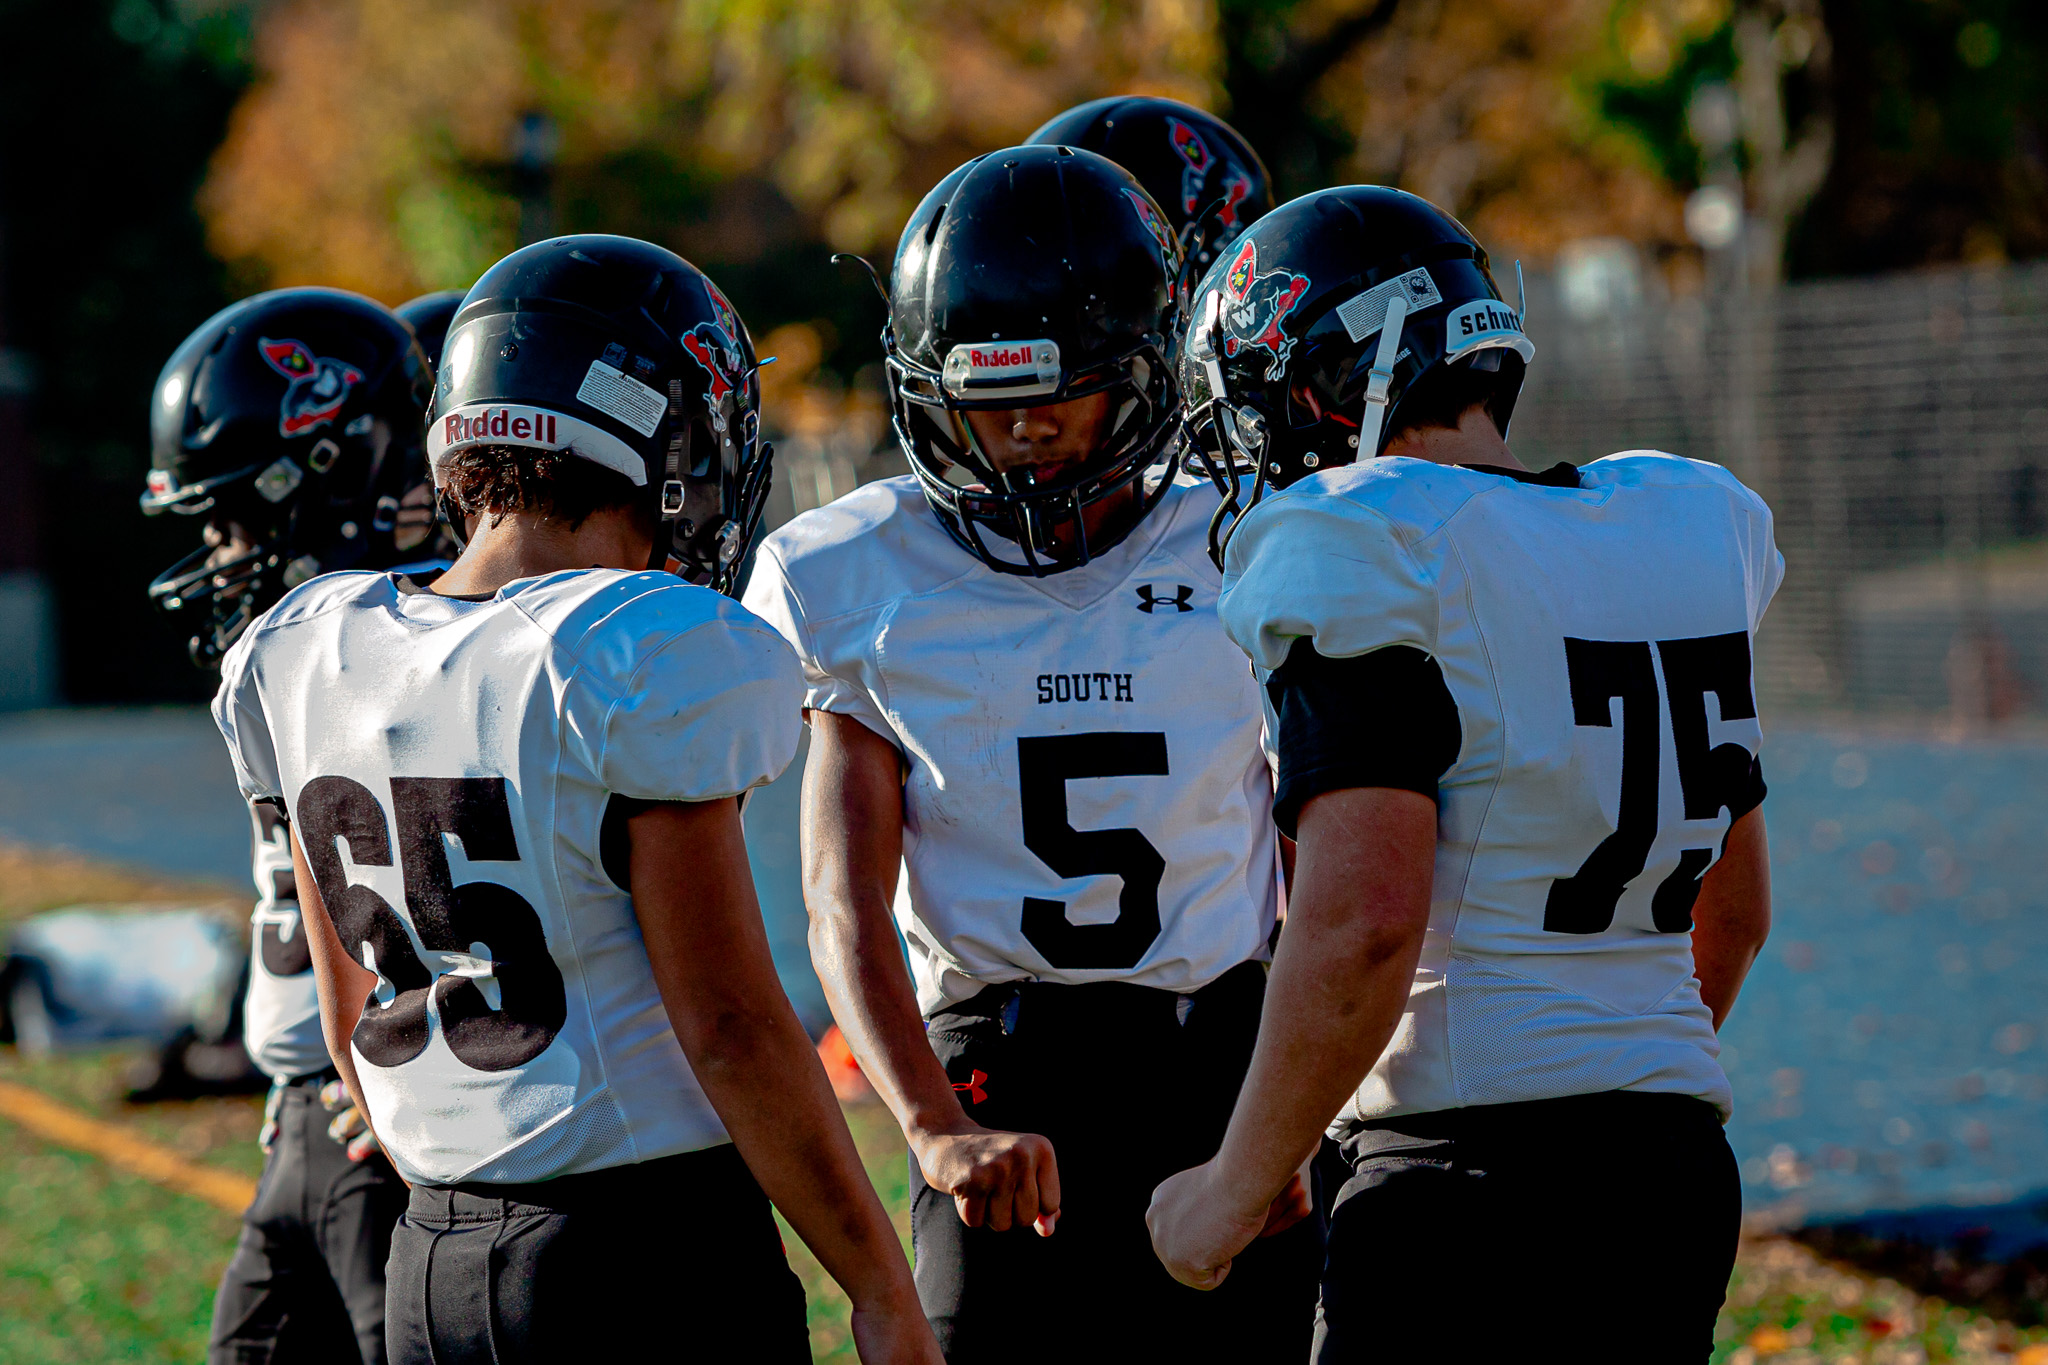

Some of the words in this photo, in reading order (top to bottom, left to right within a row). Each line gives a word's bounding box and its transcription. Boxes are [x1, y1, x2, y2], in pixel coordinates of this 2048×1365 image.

[1231, 301, 1257, 329] W
[970, 346, 1032, 367] Riddell
[445, 409, 557, 446] Riddell
[1037, 673, 1134, 704] SOUTH
[1543, 630, 1757, 934] 75
[1017, 732, 1169, 969] 5
[297, 775, 567, 1071] 65
